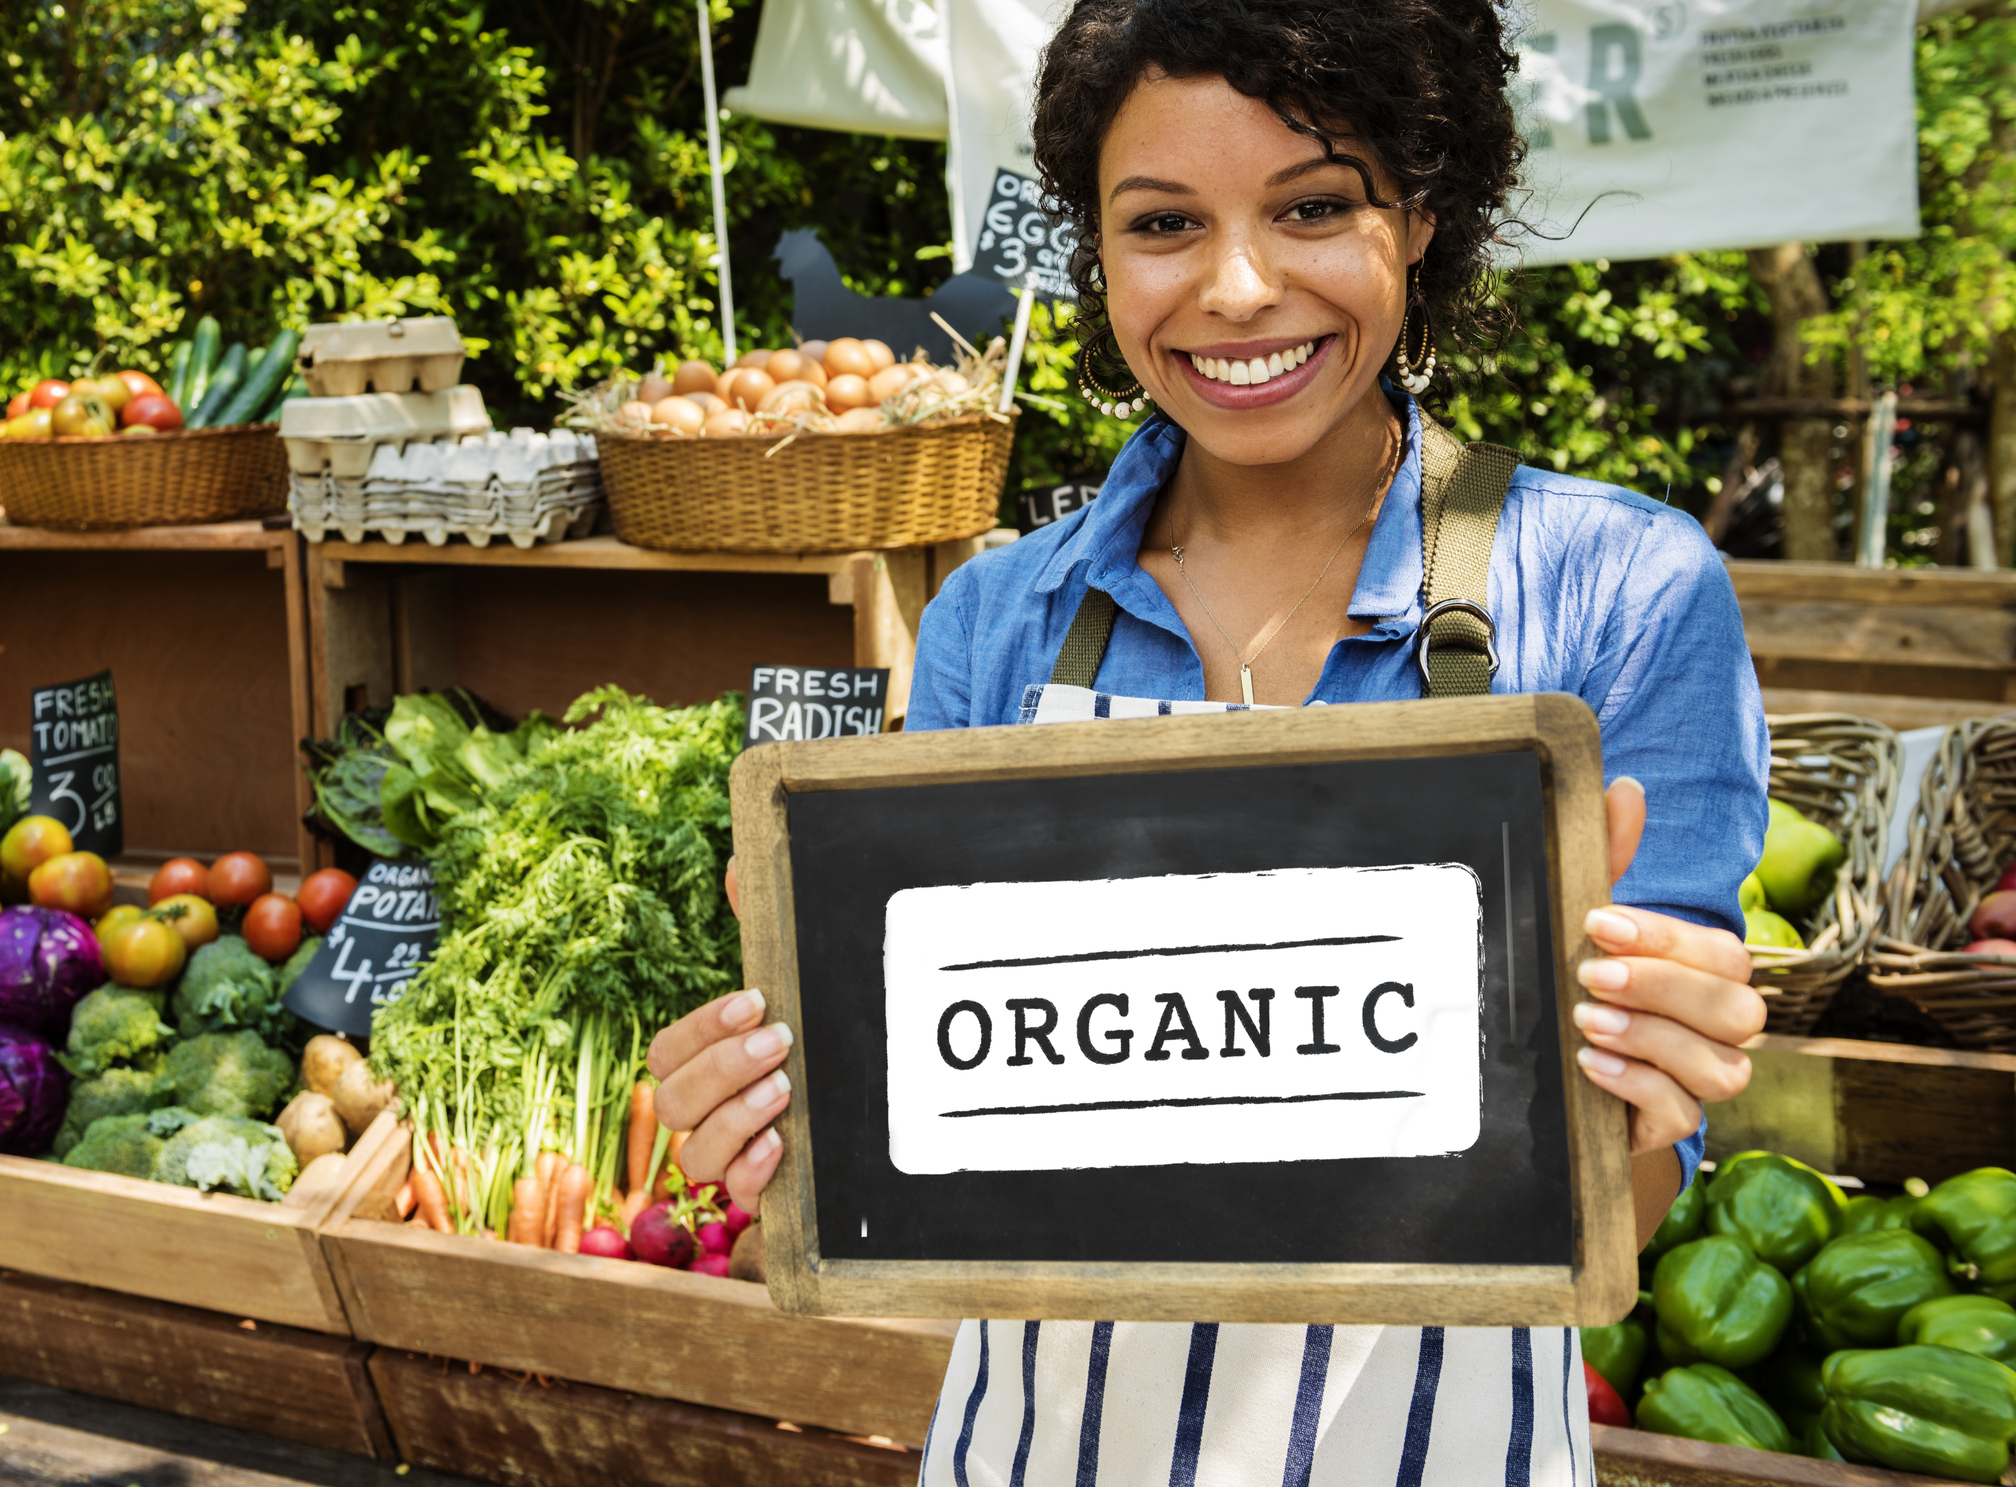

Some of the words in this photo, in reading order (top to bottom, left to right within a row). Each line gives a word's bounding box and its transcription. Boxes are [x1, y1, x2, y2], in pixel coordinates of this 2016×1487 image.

[34, 678, 114, 720] FRESH
[752, 667, 878, 699] FRESH
[749, 697, 882, 741] RADISH
[48, 770, 86, 838] 3
[936, 981, 1418, 1071] ORGANIC
